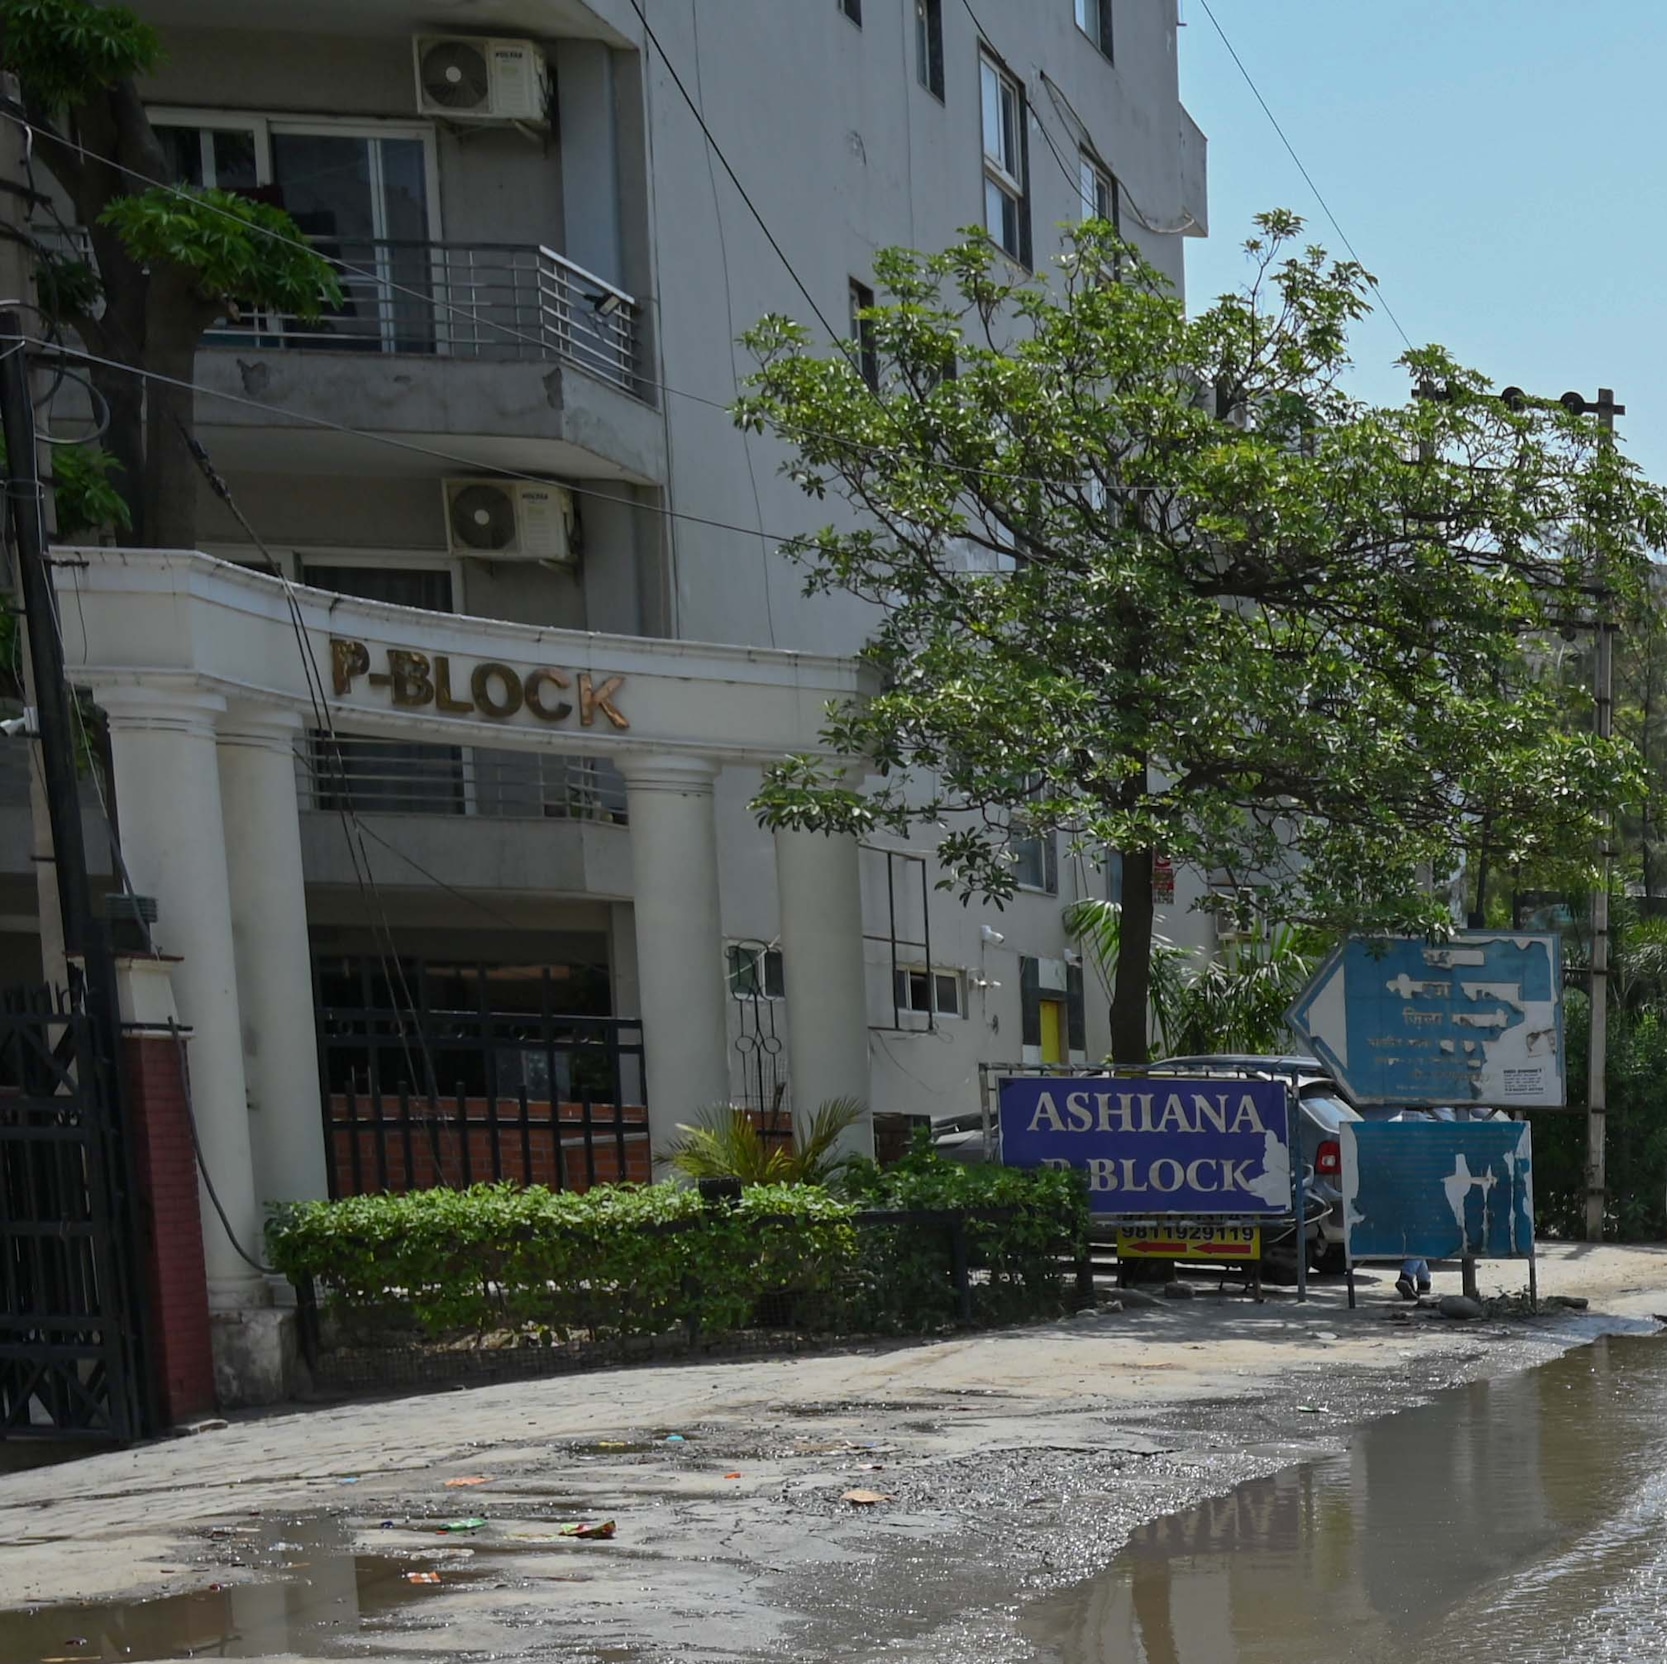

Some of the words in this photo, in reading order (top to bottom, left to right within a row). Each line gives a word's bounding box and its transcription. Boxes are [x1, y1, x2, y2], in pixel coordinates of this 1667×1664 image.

[329, 638, 630, 729] P-BLOCK
[1026, 1091, 1268, 1134] ASHIANA
[1086, 1158, 1256, 1193] BLOCK
